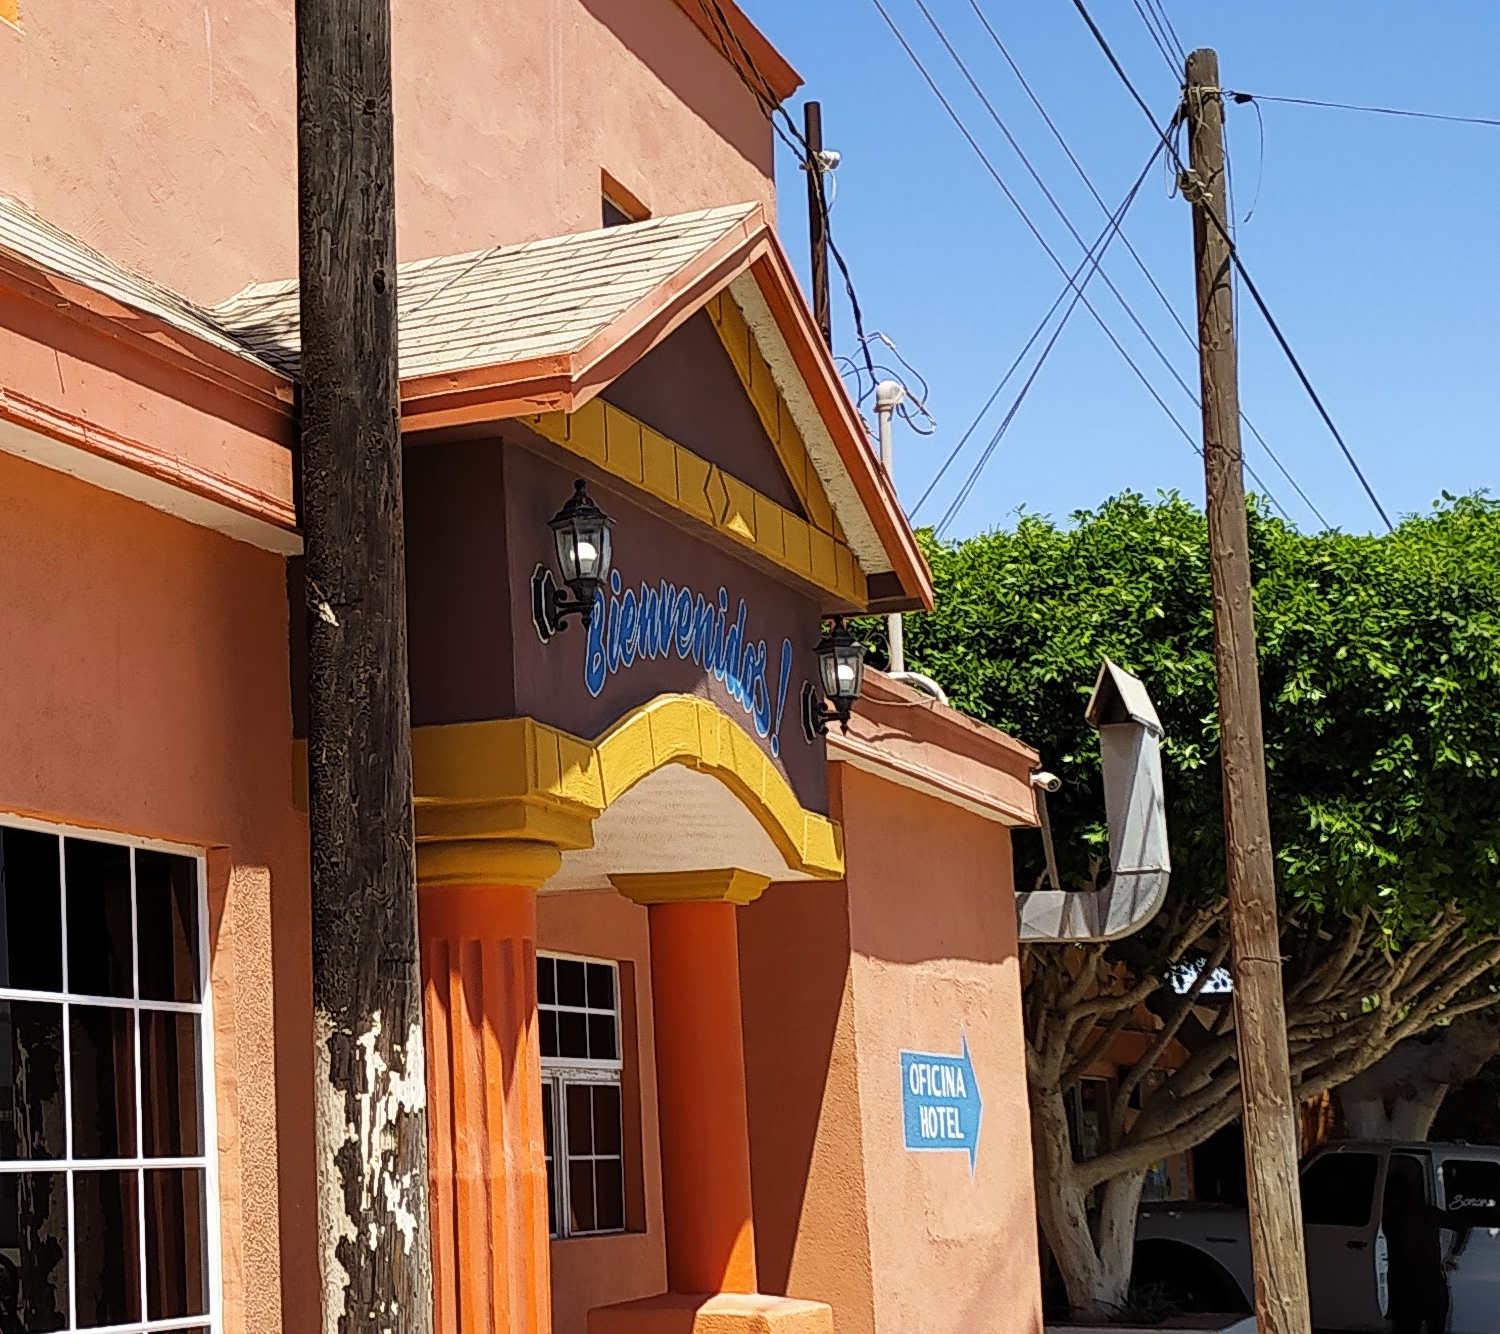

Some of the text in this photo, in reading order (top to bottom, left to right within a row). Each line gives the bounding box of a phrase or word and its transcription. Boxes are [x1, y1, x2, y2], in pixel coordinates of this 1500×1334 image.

[585, 568, 793, 758] Bienvenidos!
[909, 1063, 967, 1099] OFICINA
[919, 1105, 965, 1140] HOTEL
